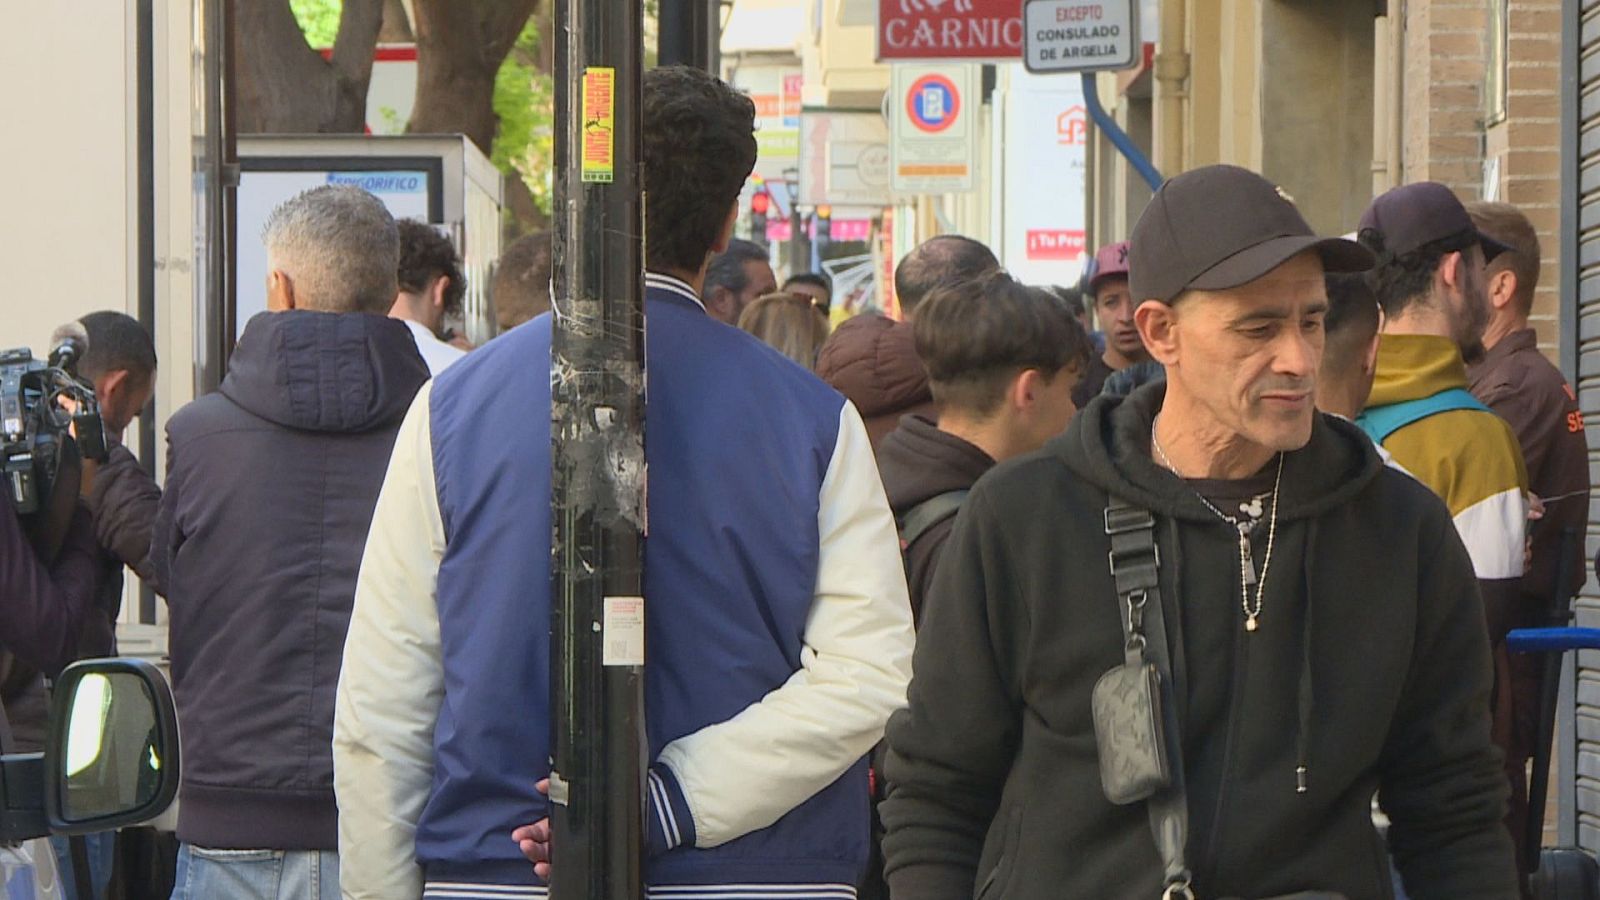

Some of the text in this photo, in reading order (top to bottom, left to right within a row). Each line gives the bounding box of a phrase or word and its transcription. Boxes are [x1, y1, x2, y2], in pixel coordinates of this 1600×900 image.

[1056, 5, 1103, 22] EXCEPTO
[1037, 25, 1119, 41] CONSULADO
[1040, 44, 1117, 60] DE ARGELIA
[1040, 235, 1056, 247] Tu
